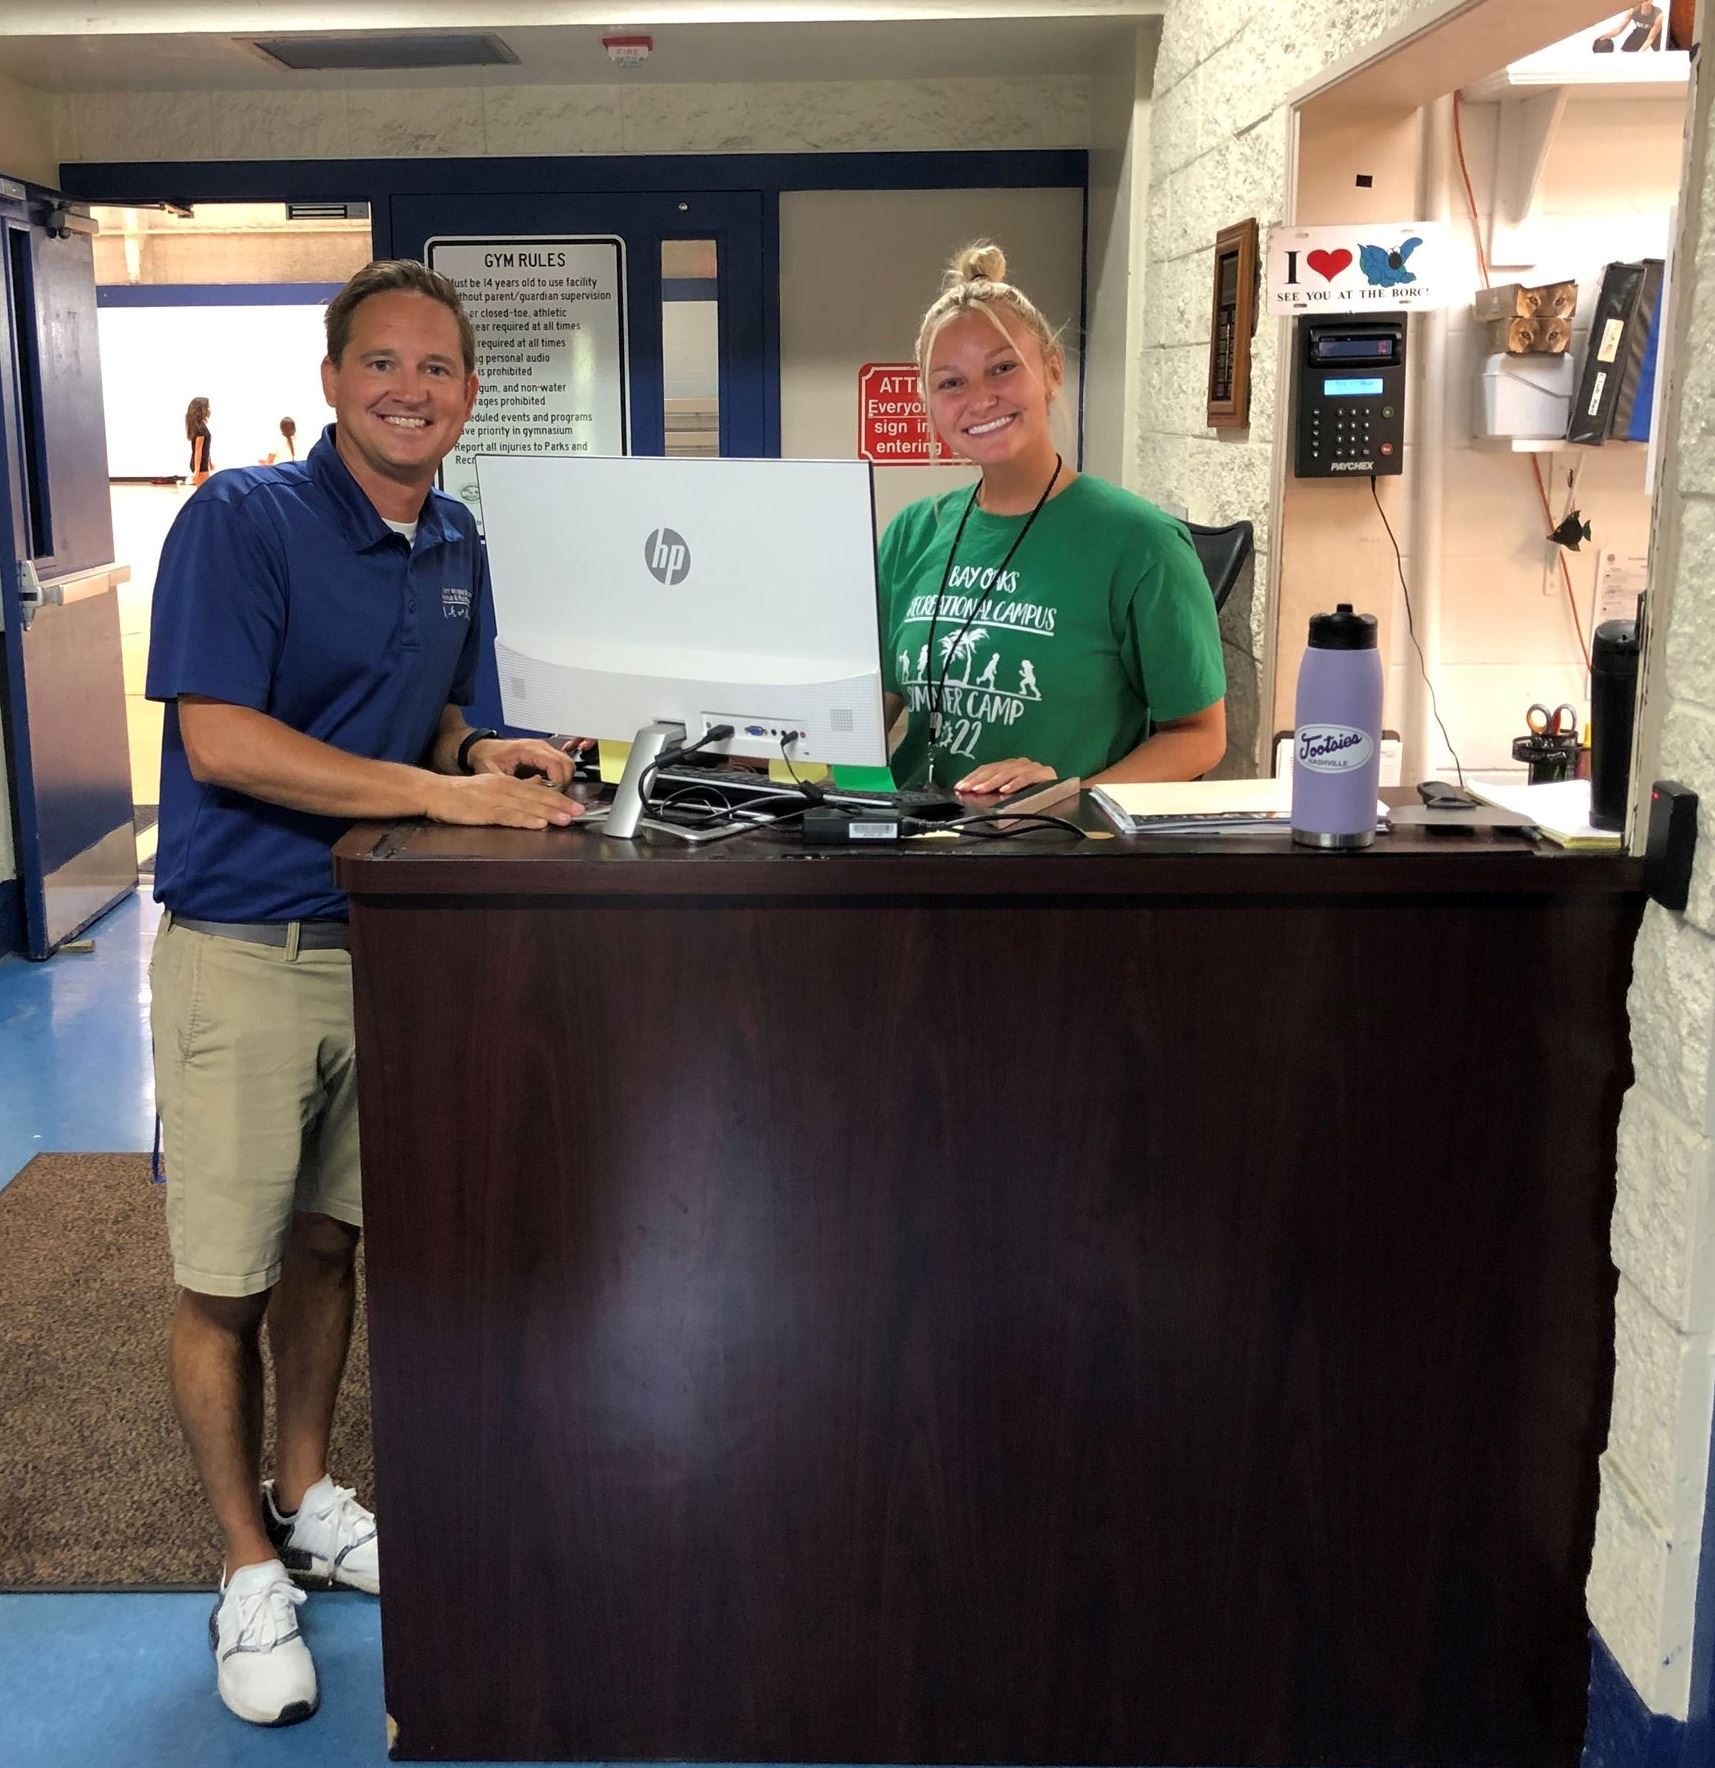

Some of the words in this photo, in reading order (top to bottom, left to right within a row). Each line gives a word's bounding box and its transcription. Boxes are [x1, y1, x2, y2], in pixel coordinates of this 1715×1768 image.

[484, 253, 514, 268] GYM
[519, 252, 566, 268] RULES
[1283, 251, 1302, 285] I
[469, 278, 481, 288] be
[483, 278, 493, 288] 14
[495, 279, 520, 291] years
[521, 278, 535, 287] old
[537, 278, 547, 287] to
[548, 279, 564, 287] use
[566, 277, 598, 289] facility
[484, 291, 559, 303] parent/guardian
[560, 291, 612, 303] supervision
[1277, 291, 1300, 302] SEE
[1306, 291, 1331, 301] YOU
[1338, 290, 1353, 300] AT
[1359, 289, 1385, 299] THE
[533, 307, 567, 318] athletic
[475, 323, 490, 331] ear
[492, 321, 530, 333] required
[531, 322, 541, 331] at
[543, 321, 554, 331] all
[556, 321, 581, 331] times
[477, 338, 515, 350] required
[517, 338, 526, 347] at
[528, 338, 539, 347] all
[541, 338, 566, 347] times
[485, 353, 524, 365] personal
[526, 353, 550, 362] audio
[486, 366, 533, 378] prohibited
[503, 383, 519, 392] and
[520, 382, 567, 392] non-water
[880, 377, 921, 393] ATT
[500, 396, 546, 407] prohibited
[501, 413, 530, 422] events
[532, 412, 549, 421] and
[550, 413, 593, 424] programs
[477, 426, 510, 437] priority
[512, 426, 520, 435] in
[522, 426, 573, 437] gymnasium
[874, 419, 908, 436] sign
[454, 442, 484, 454] Report
[486, 442, 497, 451] all
[499, 442, 532, 454] injuries
[533, 442, 543, 451] to
[544, 441, 570, 451] Parks
[571, 442, 588, 451] and
[455, 455, 476, 465] Recr
[1330, 461, 1374, 471] PAYCHEX
[652, 527, 686, 584] hp
[948, 565, 982, 589] BAY
[992, 600, 1057, 631] CAMPUS
[966, 690, 1025, 726] CAMP
[1300, 733, 1362, 760] Tootsies
[1307, 758, 1348, 767] NASHVILLE
